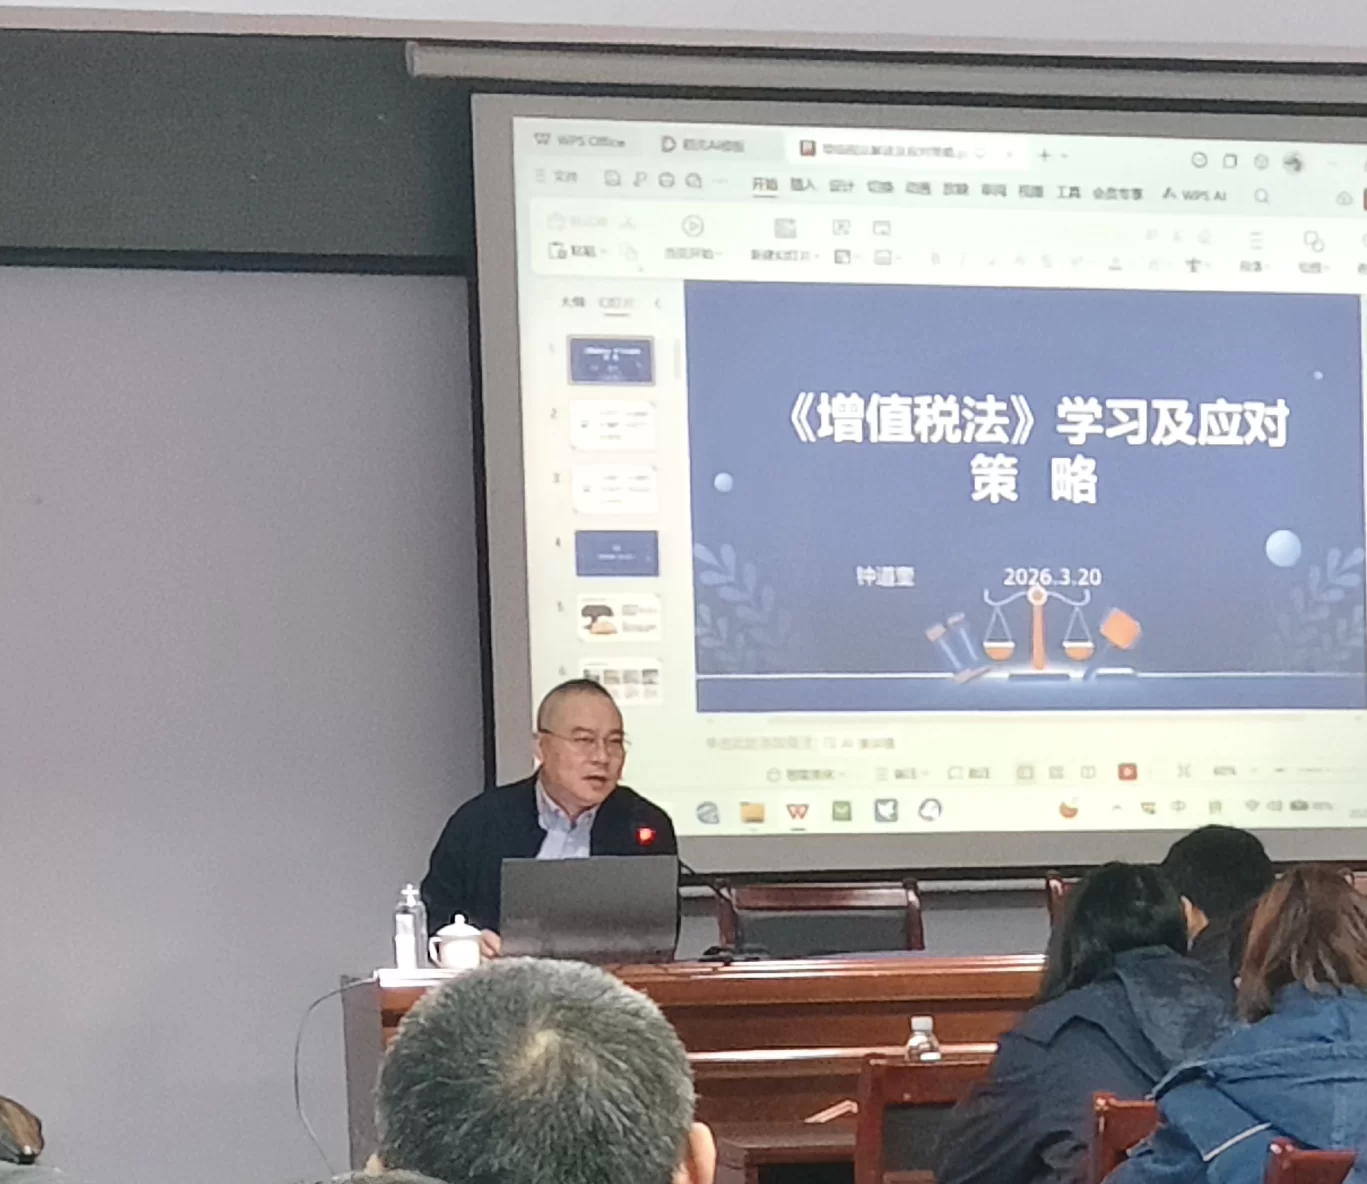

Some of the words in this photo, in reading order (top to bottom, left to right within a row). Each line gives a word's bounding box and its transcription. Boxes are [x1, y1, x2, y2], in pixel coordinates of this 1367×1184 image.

[752, 176, 778, 192] 开始
[969, 453, 1019, 505] 策
[1050, 454, 1099, 505] 略
[1003, 567, 1102, 586] 2026.3.20
